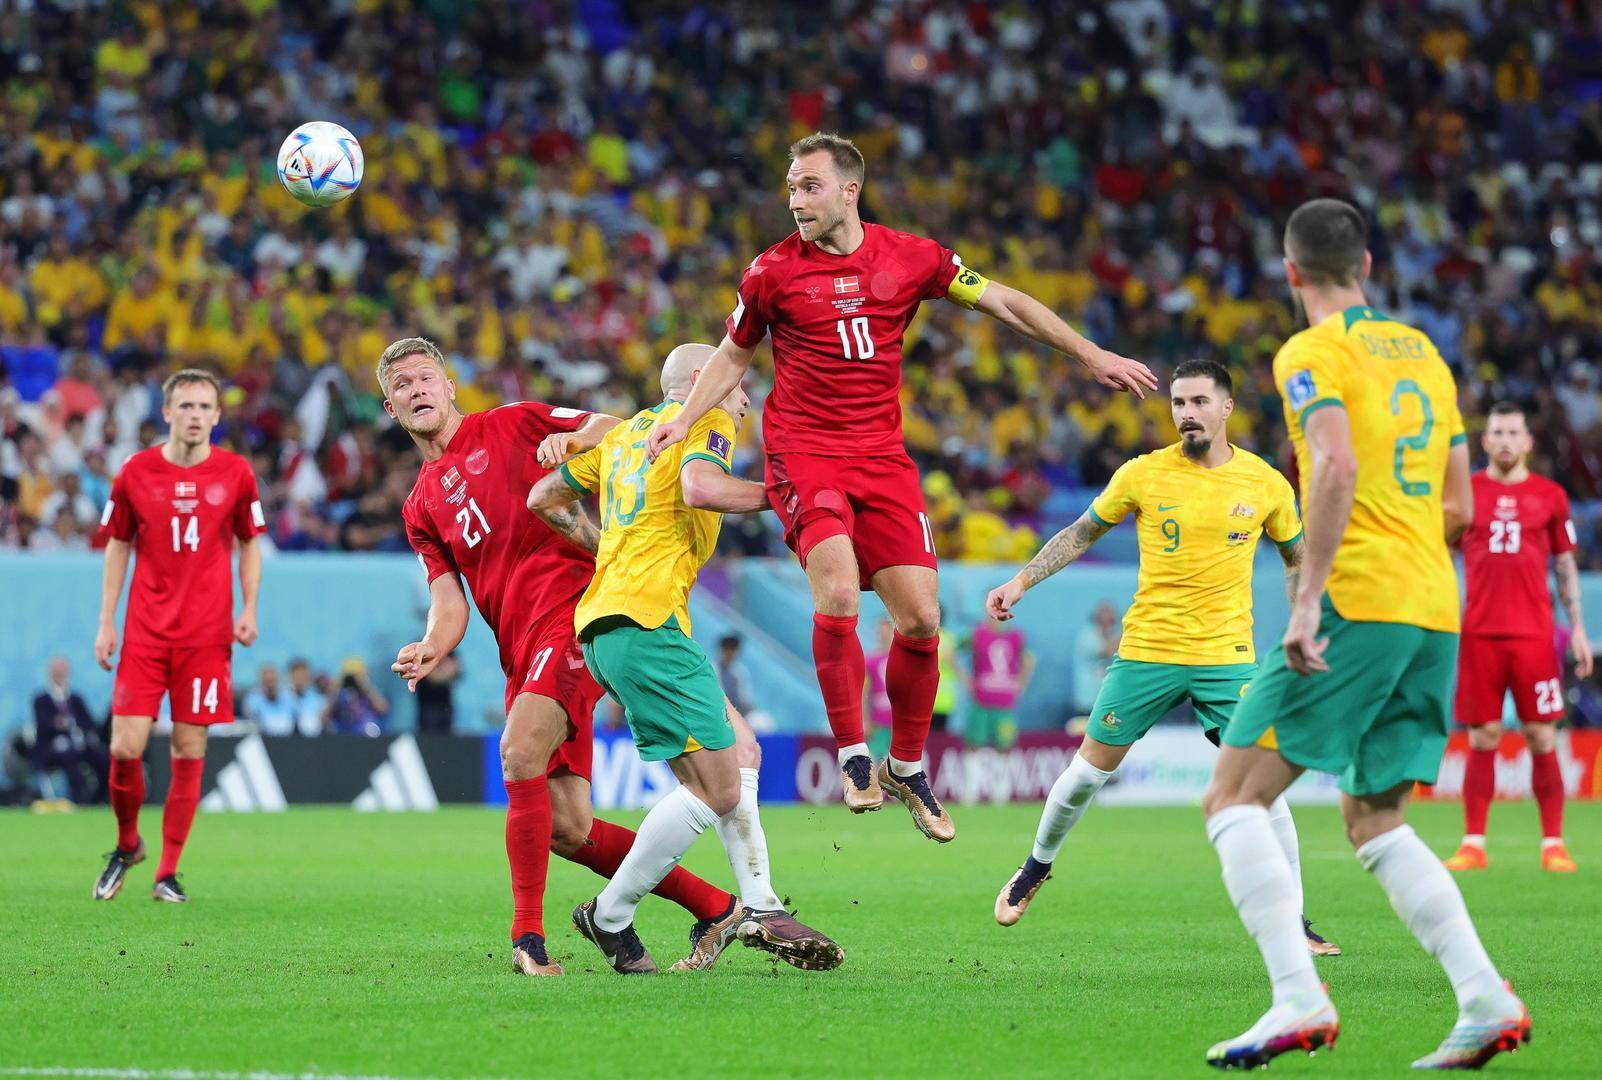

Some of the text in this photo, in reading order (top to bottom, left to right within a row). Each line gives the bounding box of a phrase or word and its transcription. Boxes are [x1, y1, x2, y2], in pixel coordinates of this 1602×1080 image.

[837, 316, 875, 360] 10
[1391, 379, 1434, 496] 2
[602, 440, 651, 532] 13
[170, 515, 200, 553] 14
[455, 497, 492, 549] 21
[918, 511, 937, 558] 1
[1161, 518, 1179, 553] 9
[1488, 519, 1522, 554] 23
[191, 677, 219, 714] 14
[1534, 677, 1565, 715] 23
[592, 737, 678, 808] VIS
[932, 747, 1079, 805] AIRWAY
